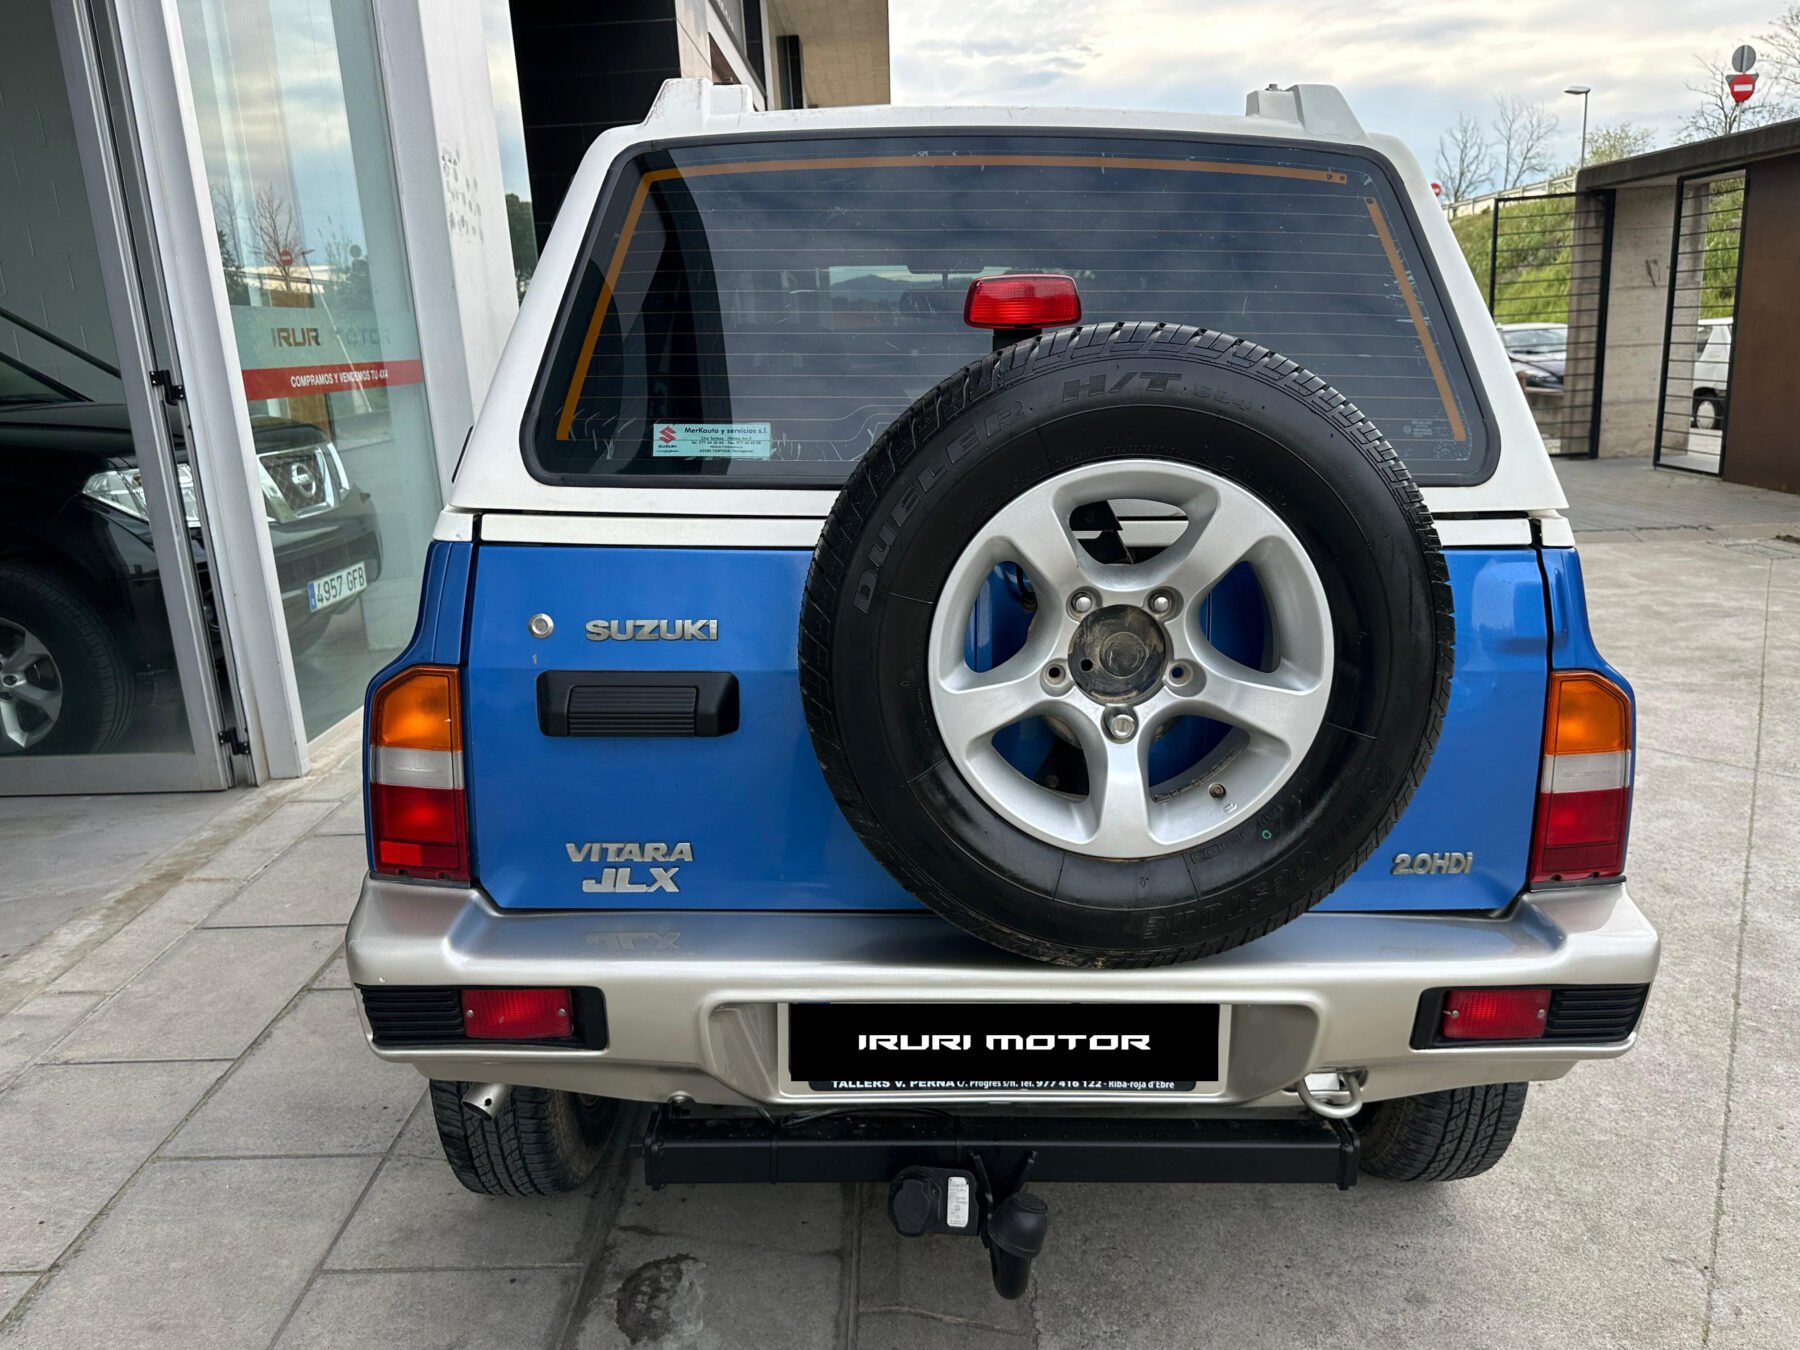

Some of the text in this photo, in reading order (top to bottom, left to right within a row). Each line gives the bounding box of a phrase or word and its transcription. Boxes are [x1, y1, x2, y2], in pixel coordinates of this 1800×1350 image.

[270, 327, 323, 347] IRUR
[290, 373, 334, 388] COMPRAMOS
[333, 372, 339, 383] Y
[339, 370, 369, 383] VENDEMOS
[370, 370, 378, 380] TU
[853, 400, 1026, 614] DUELER
[1062, 371, 1182, 401] H/T
[317, 566, 365, 604] 4957 GFB
[585, 619, 718, 641] SUZUKI
[565, 842, 693, 862] VITARA
[582, 867, 680, 893] JLX
[831, 1080, 891, 1089] TALLERS
